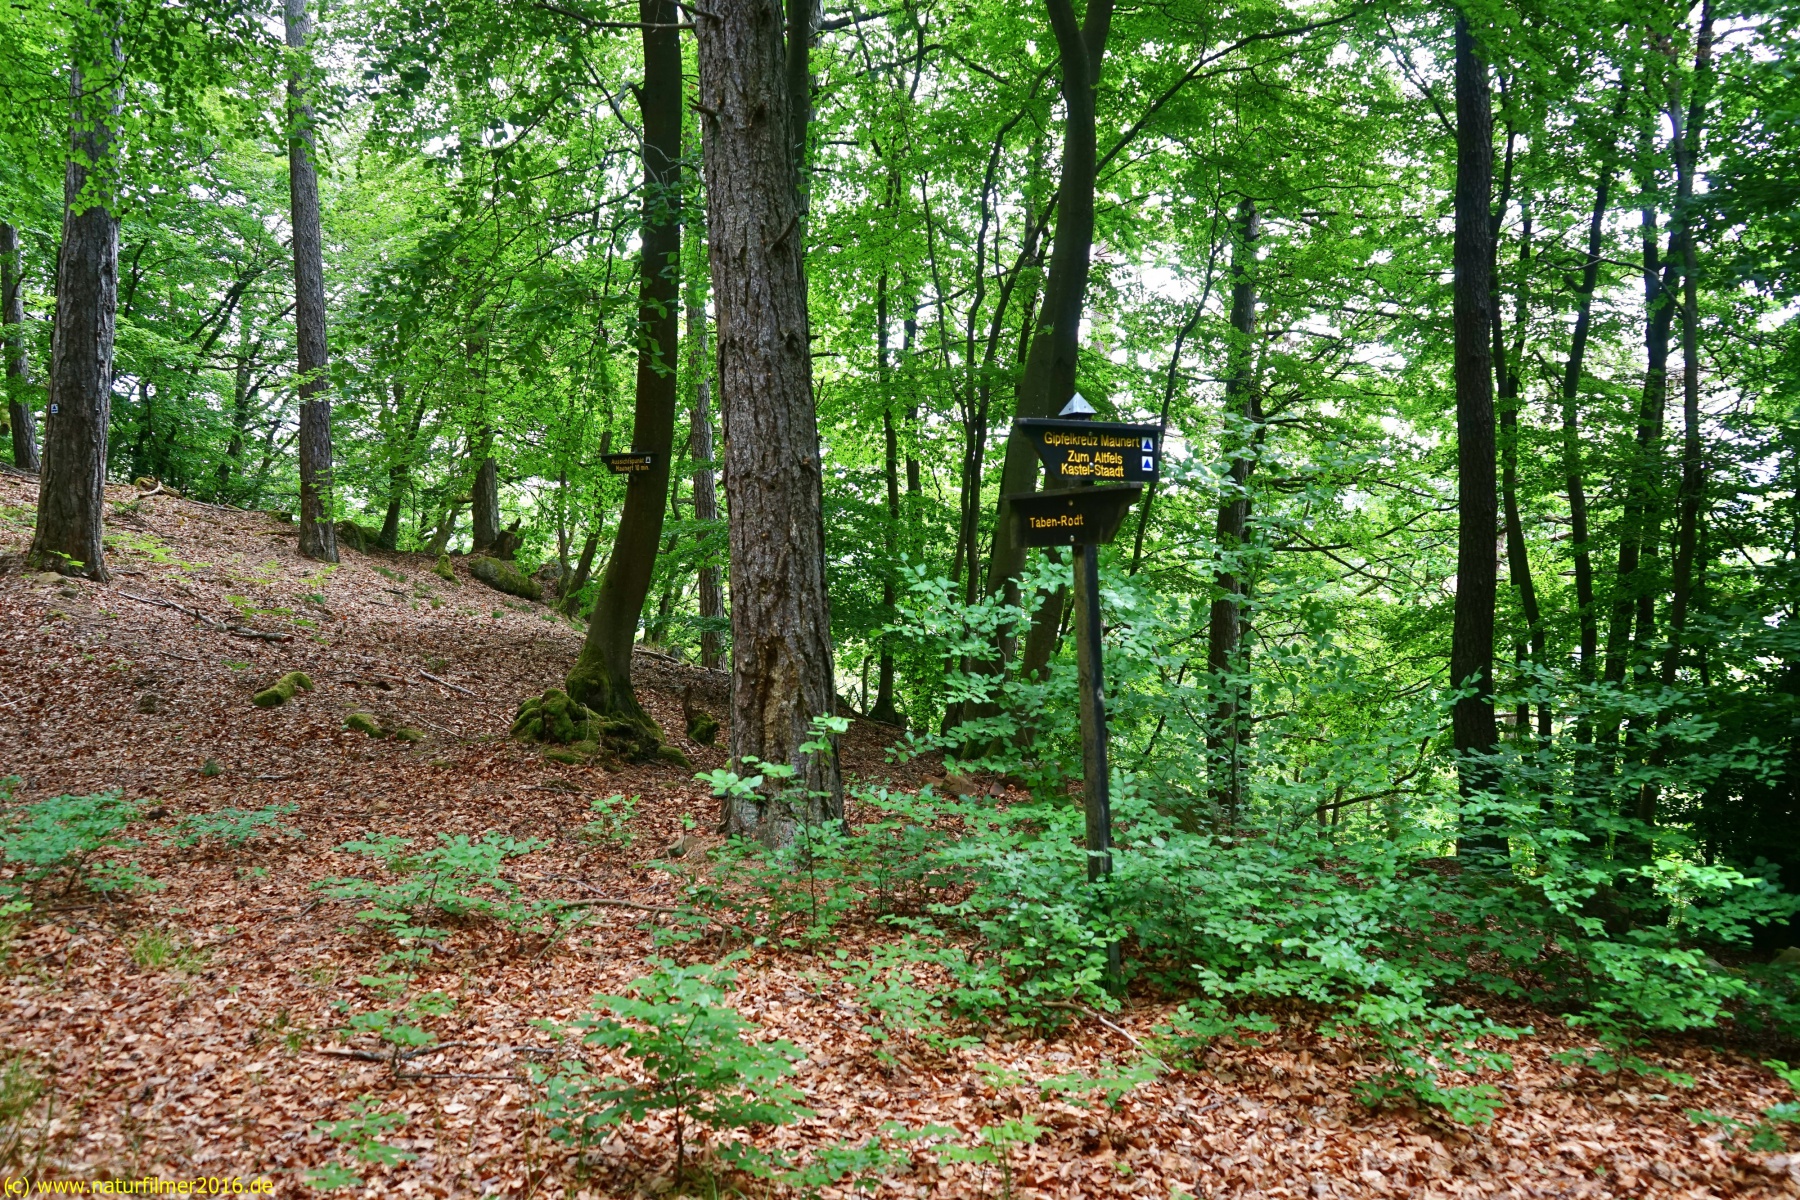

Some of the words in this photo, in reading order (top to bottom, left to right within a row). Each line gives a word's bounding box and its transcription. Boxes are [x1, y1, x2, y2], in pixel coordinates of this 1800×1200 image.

[1044, 432, 1098, 446] Gipfelkreuz
[1101, 434, 1140, 447] Maunert
[1067, 450, 1089, 463] Zum
[1094, 451, 1123, 464] Altfels
[1061, 462, 1124, 477] Kastel-Staadt
[1029, 514, 1084, 528] Taben-Rodt
